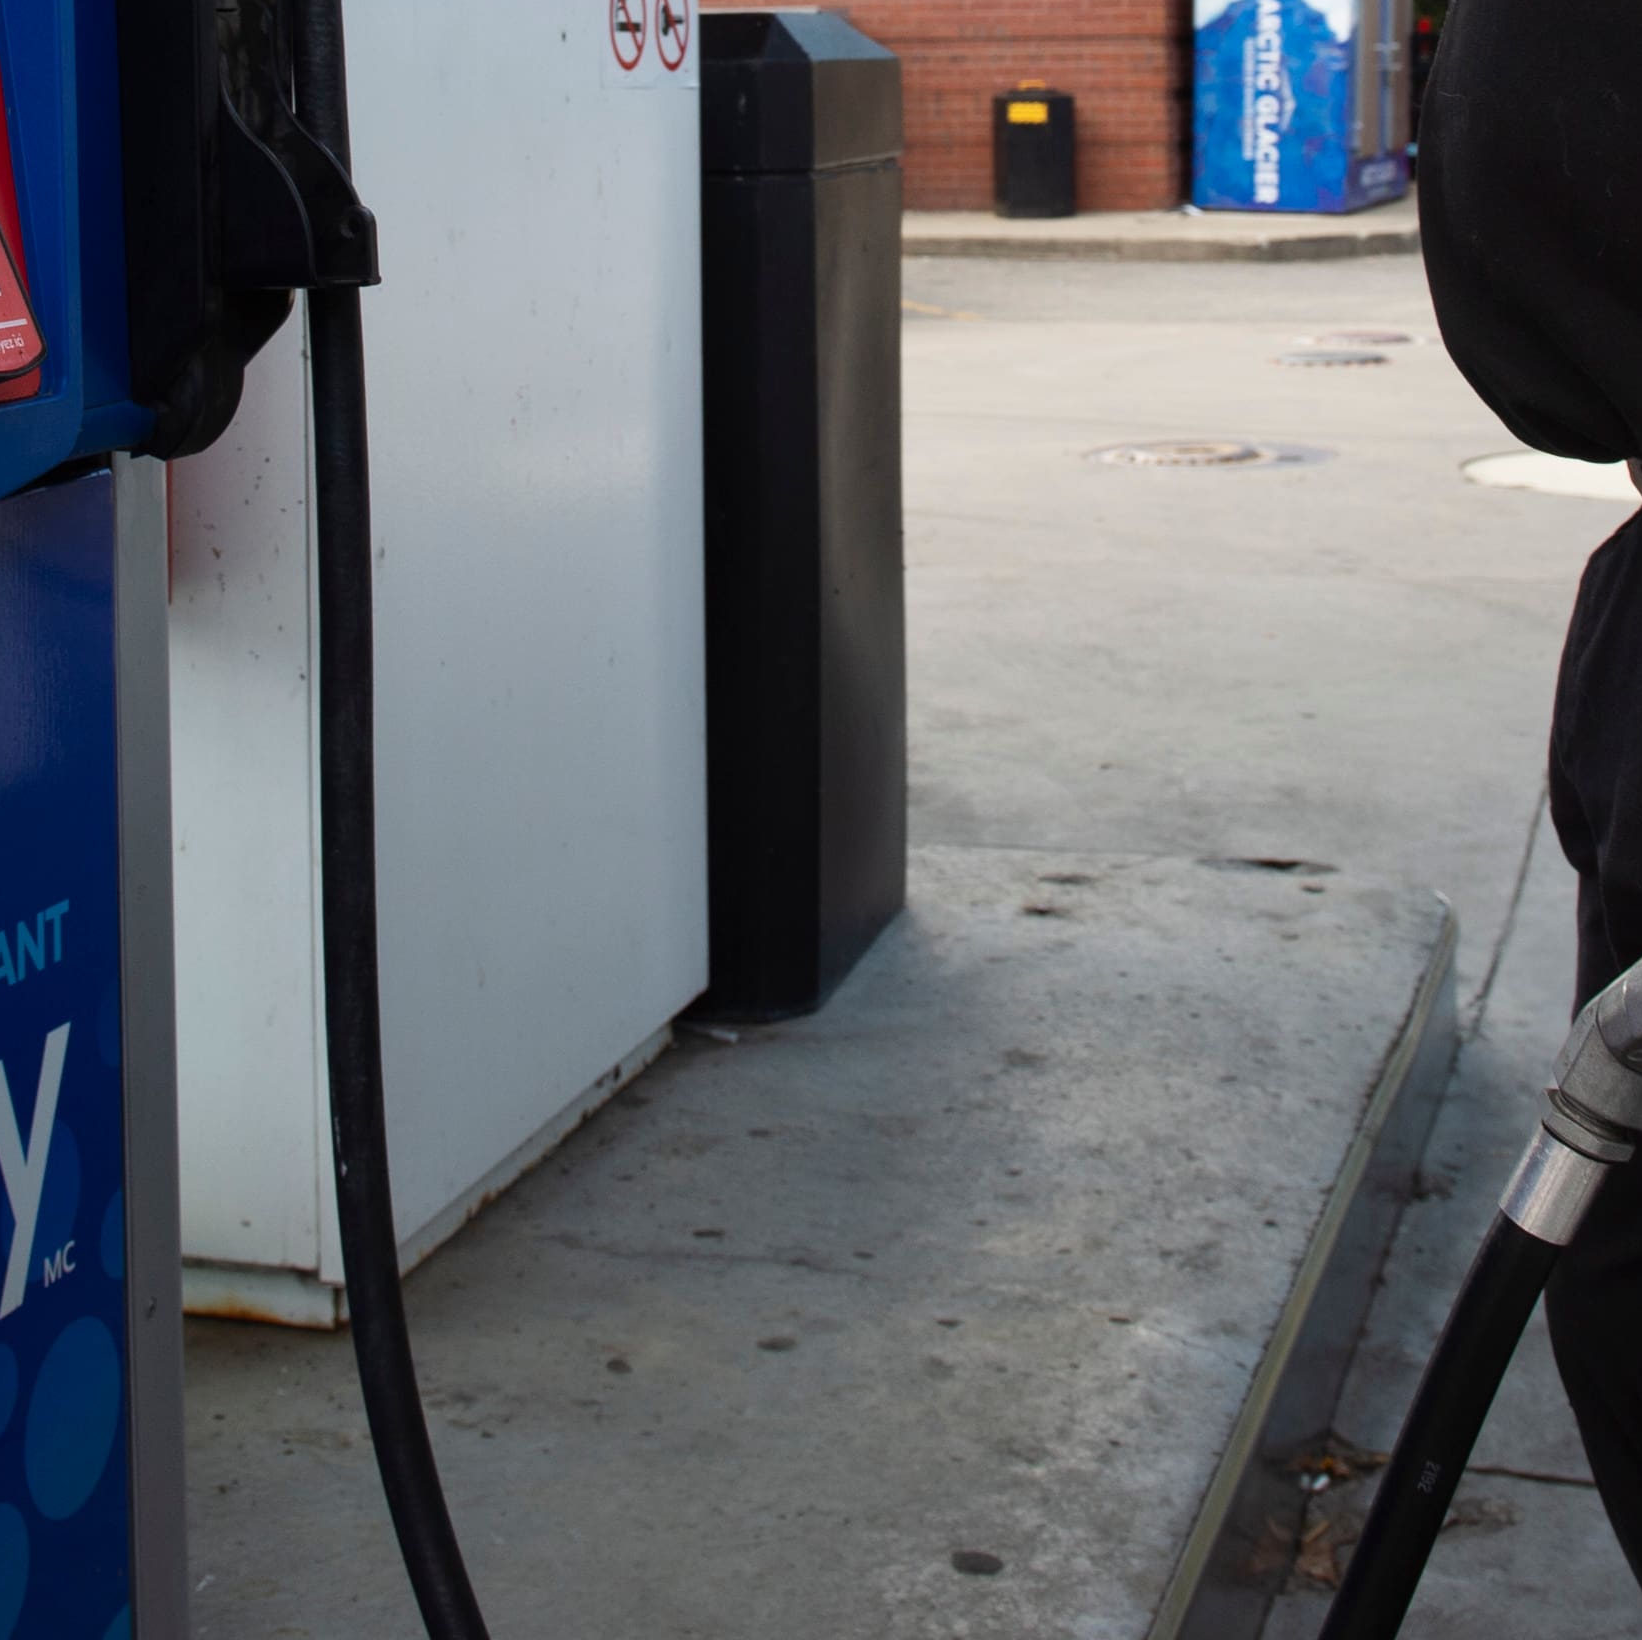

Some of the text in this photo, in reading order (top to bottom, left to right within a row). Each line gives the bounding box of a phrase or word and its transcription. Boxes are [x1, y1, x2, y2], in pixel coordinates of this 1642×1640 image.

[1254, 94, 1282, 205] GLACIER
[14, 336, 25, 351] ici
[42, 1239, 77, 1289] MC
